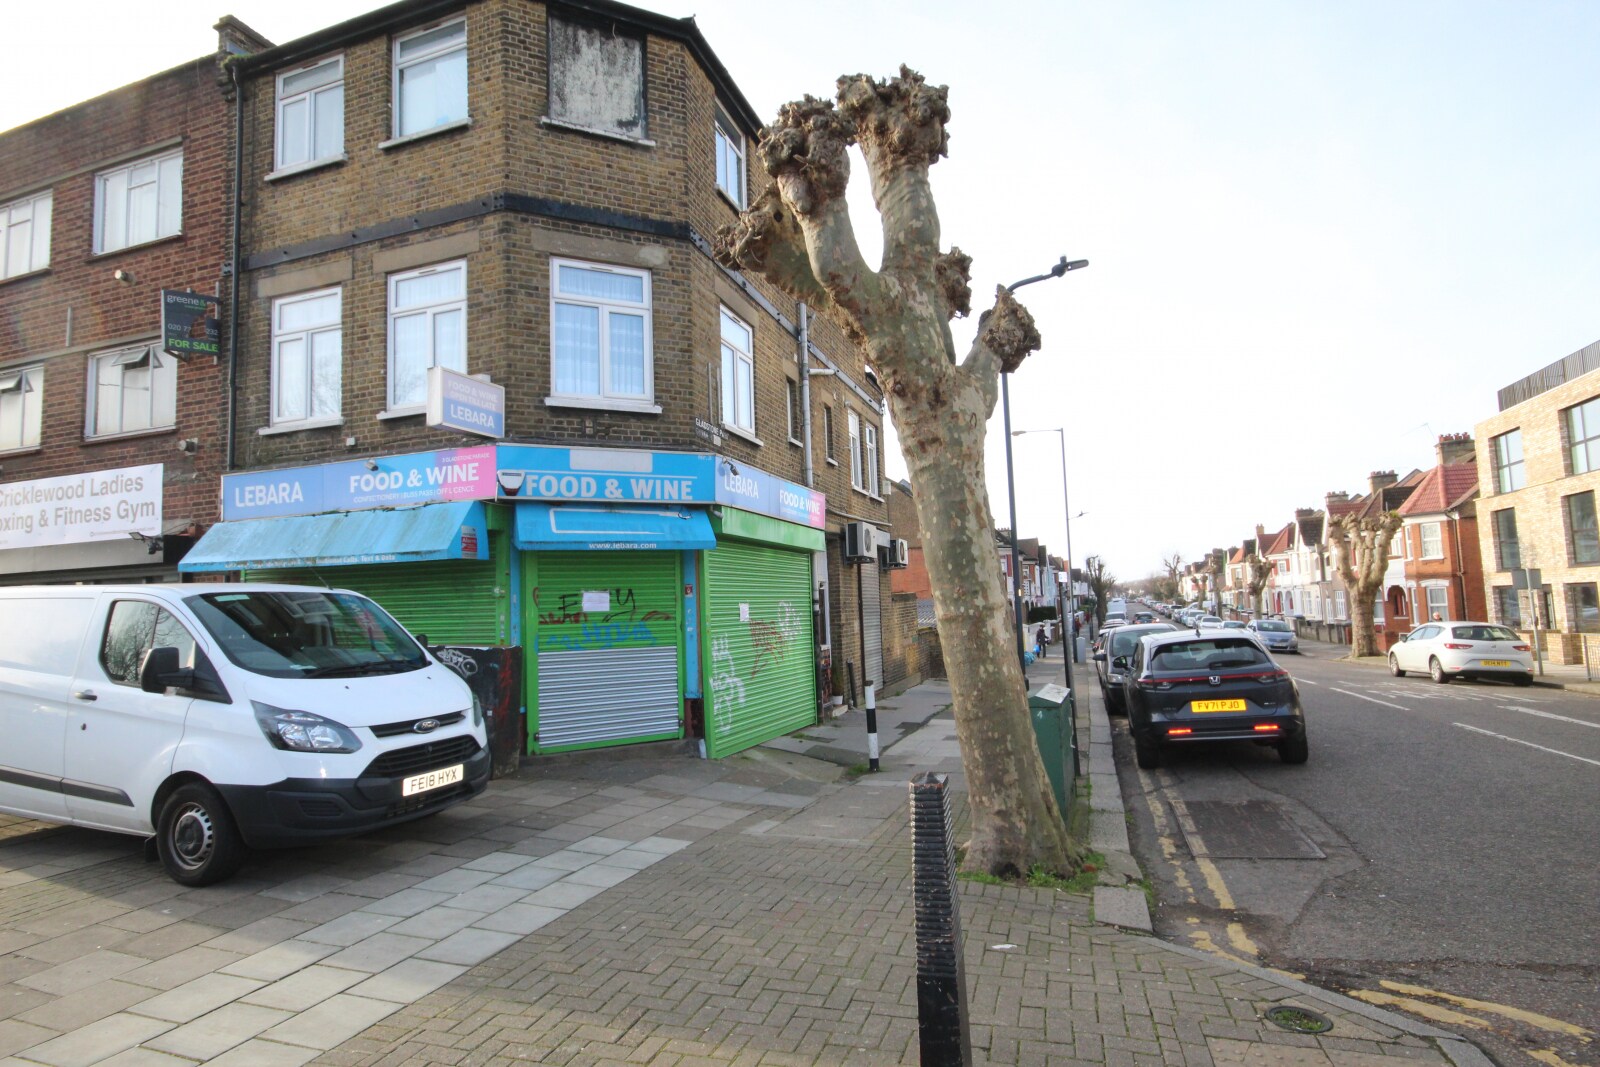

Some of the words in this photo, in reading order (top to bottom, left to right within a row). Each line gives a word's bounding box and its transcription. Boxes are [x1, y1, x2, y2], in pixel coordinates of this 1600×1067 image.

[168, 323, 181, 331] 020
[169, 338, 190, 349] FOR
[193, 342, 218, 352] SALE
[448, 380, 470, 394] FOOD
[472, 387, 477, 396] &
[478, 390, 498, 402] WINE
[450, 404, 495, 428] LEBARA
[696, 418, 718, 435] GLADSTONE
[446, 454, 472, 462] GLADSTONE
[90, 475, 144, 497] Ladies
[350, 472, 403, 493] FOOD
[407, 468, 423, 487] &
[426, 462, 479, 485] WINE
[526, 474, 596, 498] FOOD
[604, 478, 623, 499] &
[630, 479, 693, 500] WINE
[724, 474, 759, 499] LEBARA
[235, 481, 304, 508] LEBARA
[354, 494, 400, 503] CONFECTIONERY
[780, 490, 799, 508] FOOD
[800, 496, 804, 510] &
[806, 498, 820, 515] WINE
[39, 509, 48, 528] &
[54, 505, 111, 526] Fitness
[117, 499, 155, 524] Gym
[1198, 702, 1219, 710] FV71
[422, 721, 436, 729] Ford
[411, 774, 435, 792] FE18
[438, 768, 457, 784] HYX
